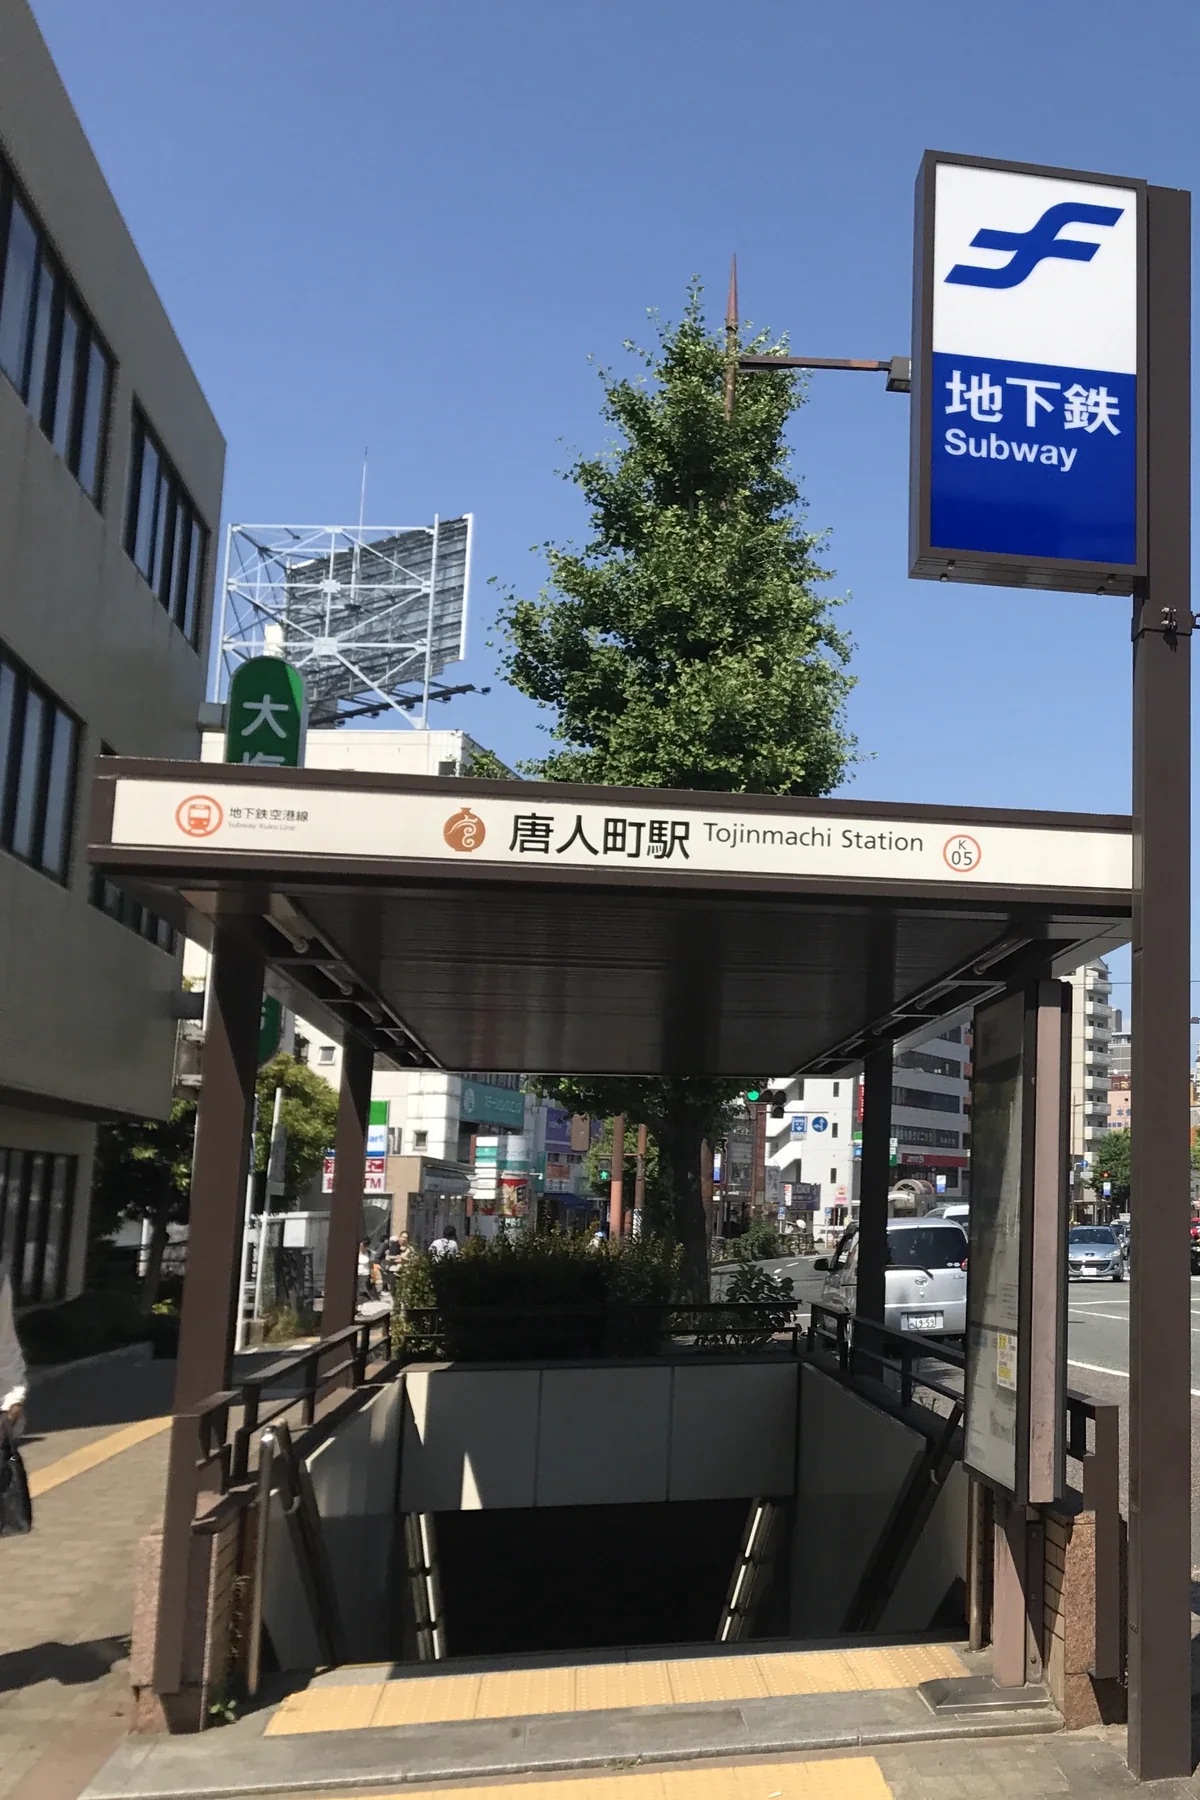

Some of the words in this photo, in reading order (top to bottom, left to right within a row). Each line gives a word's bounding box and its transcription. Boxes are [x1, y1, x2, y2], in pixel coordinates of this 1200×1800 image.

[944, 369, 1121, 436] 地下鉄
[944, 428, 1078, 472] Subway
[228, 821, 256, 830] Subway
[229, 807, 309, 822] 地下鉄空港線
[508, 812, 691, 860] 唐人町駅
[703, 822, 832, 849] Tojinmachi
[841, 829, 923, 853] Station
[958, 840, 967, 851] K
[951, 850, 973, 866] 05
